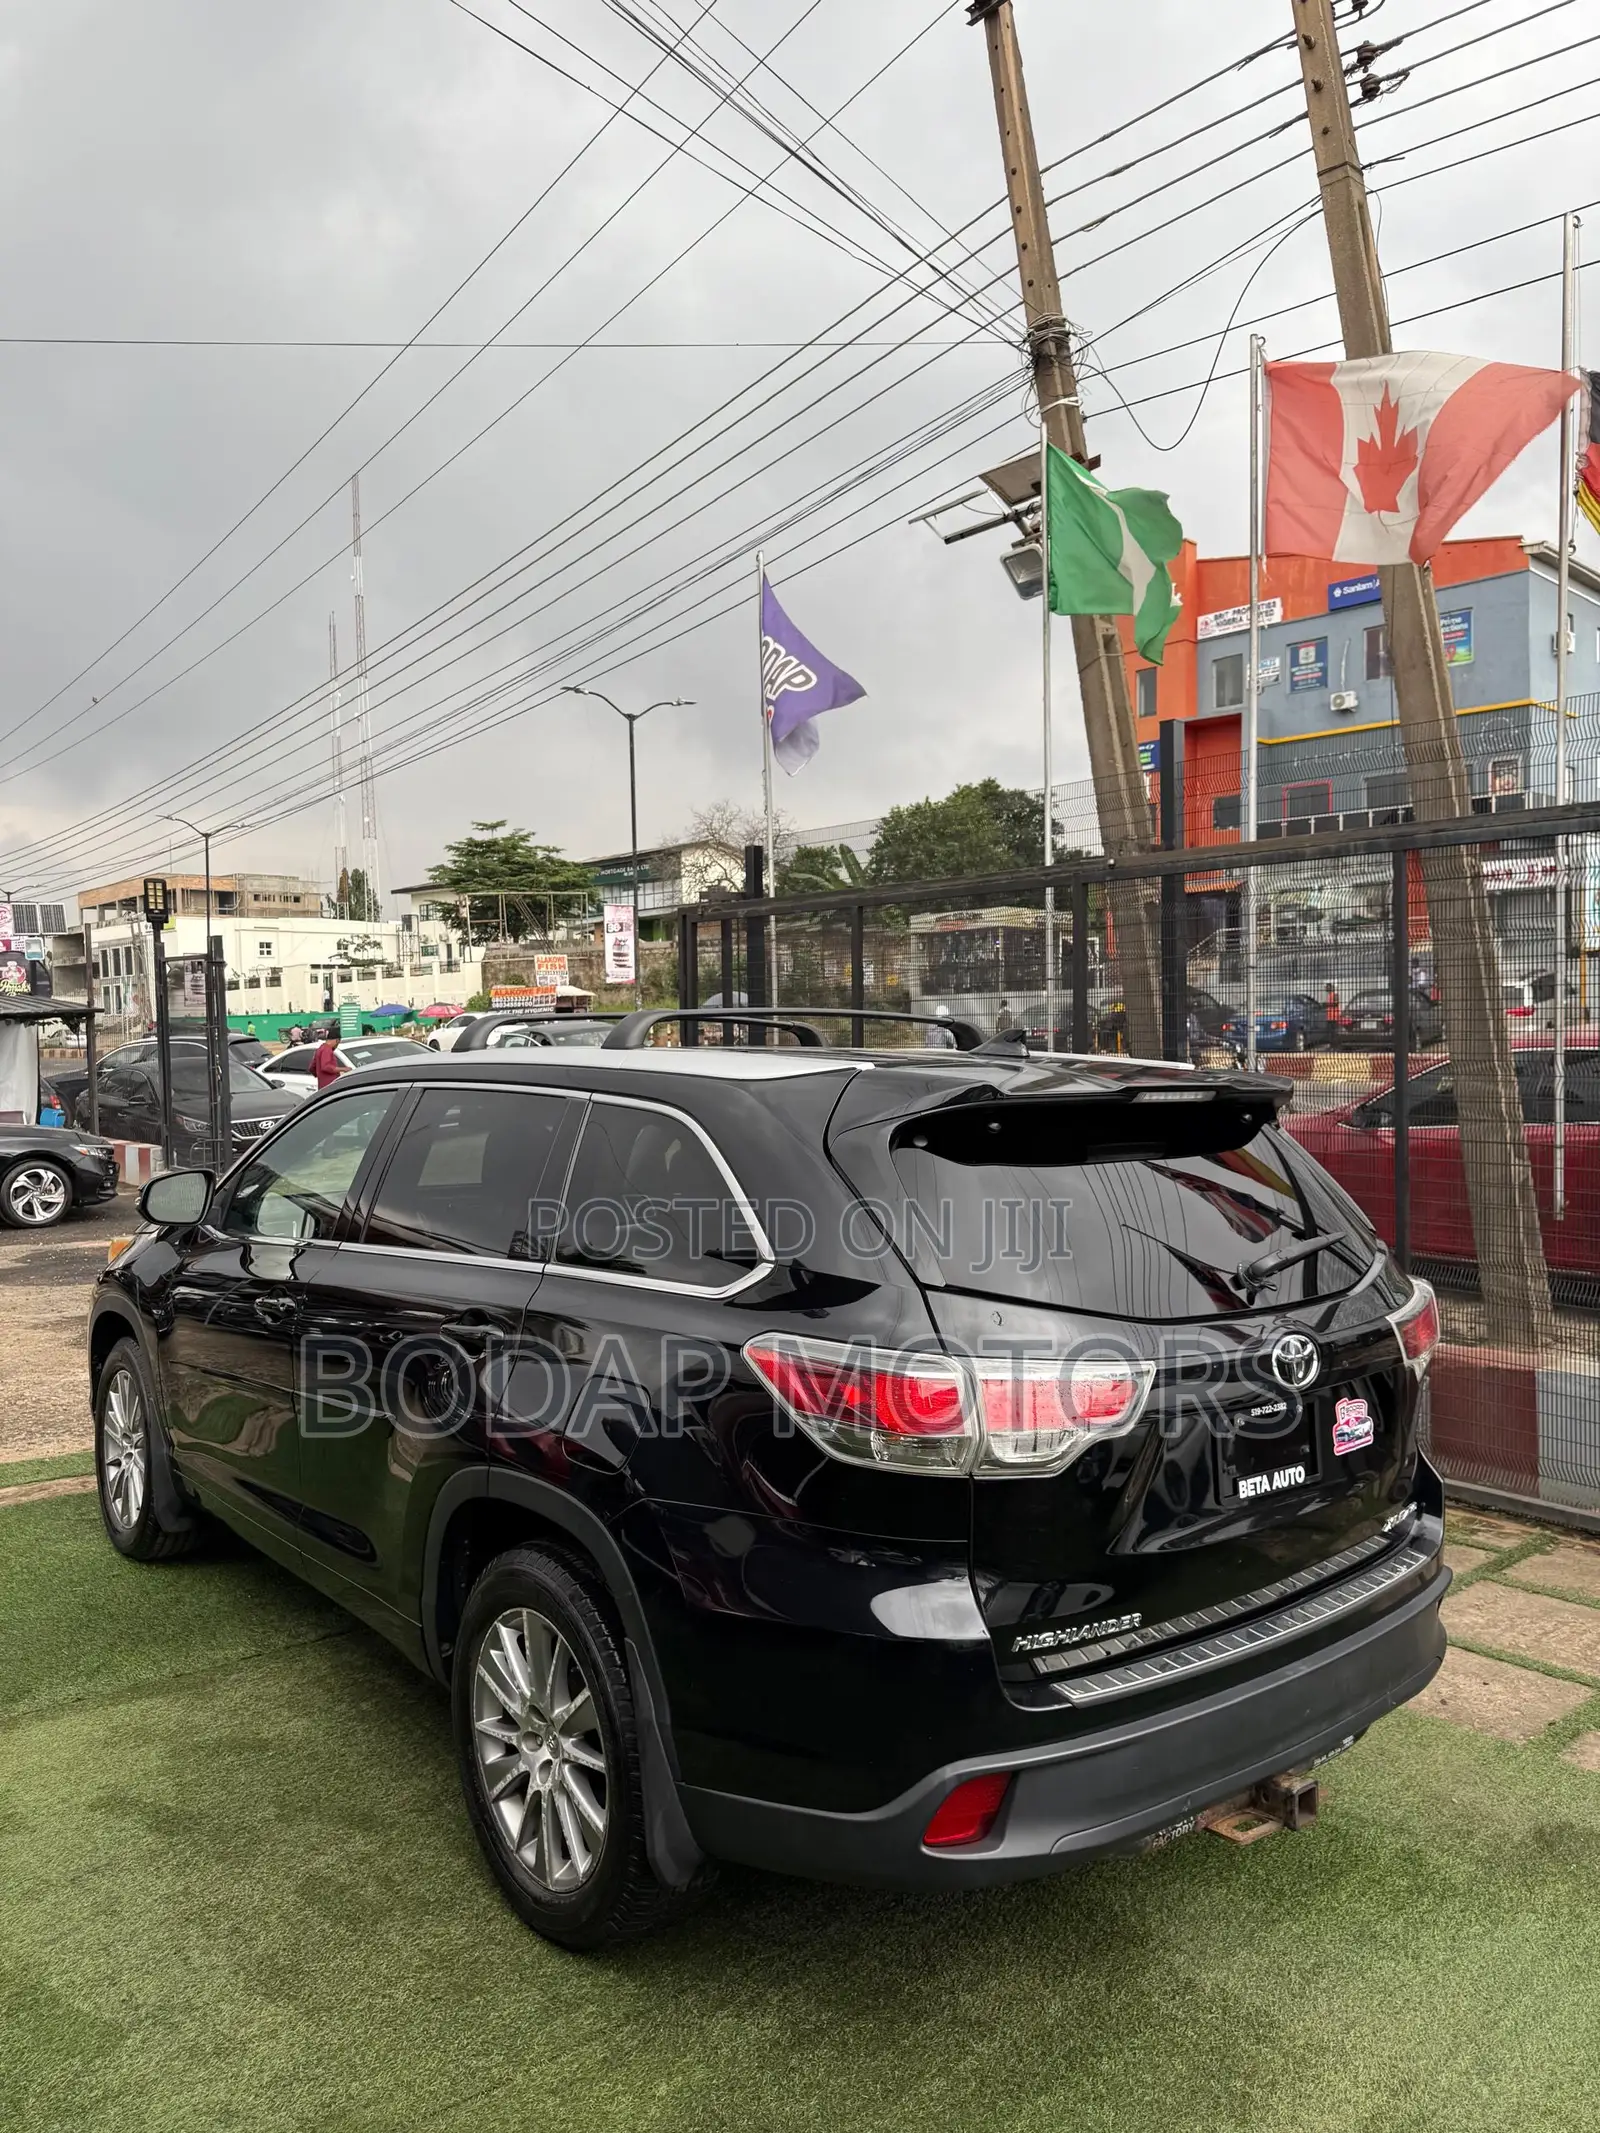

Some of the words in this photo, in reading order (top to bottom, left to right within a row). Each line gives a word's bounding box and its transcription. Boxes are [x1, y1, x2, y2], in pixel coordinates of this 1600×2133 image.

[1343, 582, 1373, 595] Sanlam
[1214, 611, 1230, 620] BRIT
[494, 987, 535, 996] ALAKOWE
[1238, 1478, 1271, 1499] BETA
[1272, 1465, 1306, 1491] AUTO
[1011, 1612, 1142, 1652] HIGHLANDER
[1152, 1820, 1196, 1849] FACTORY
